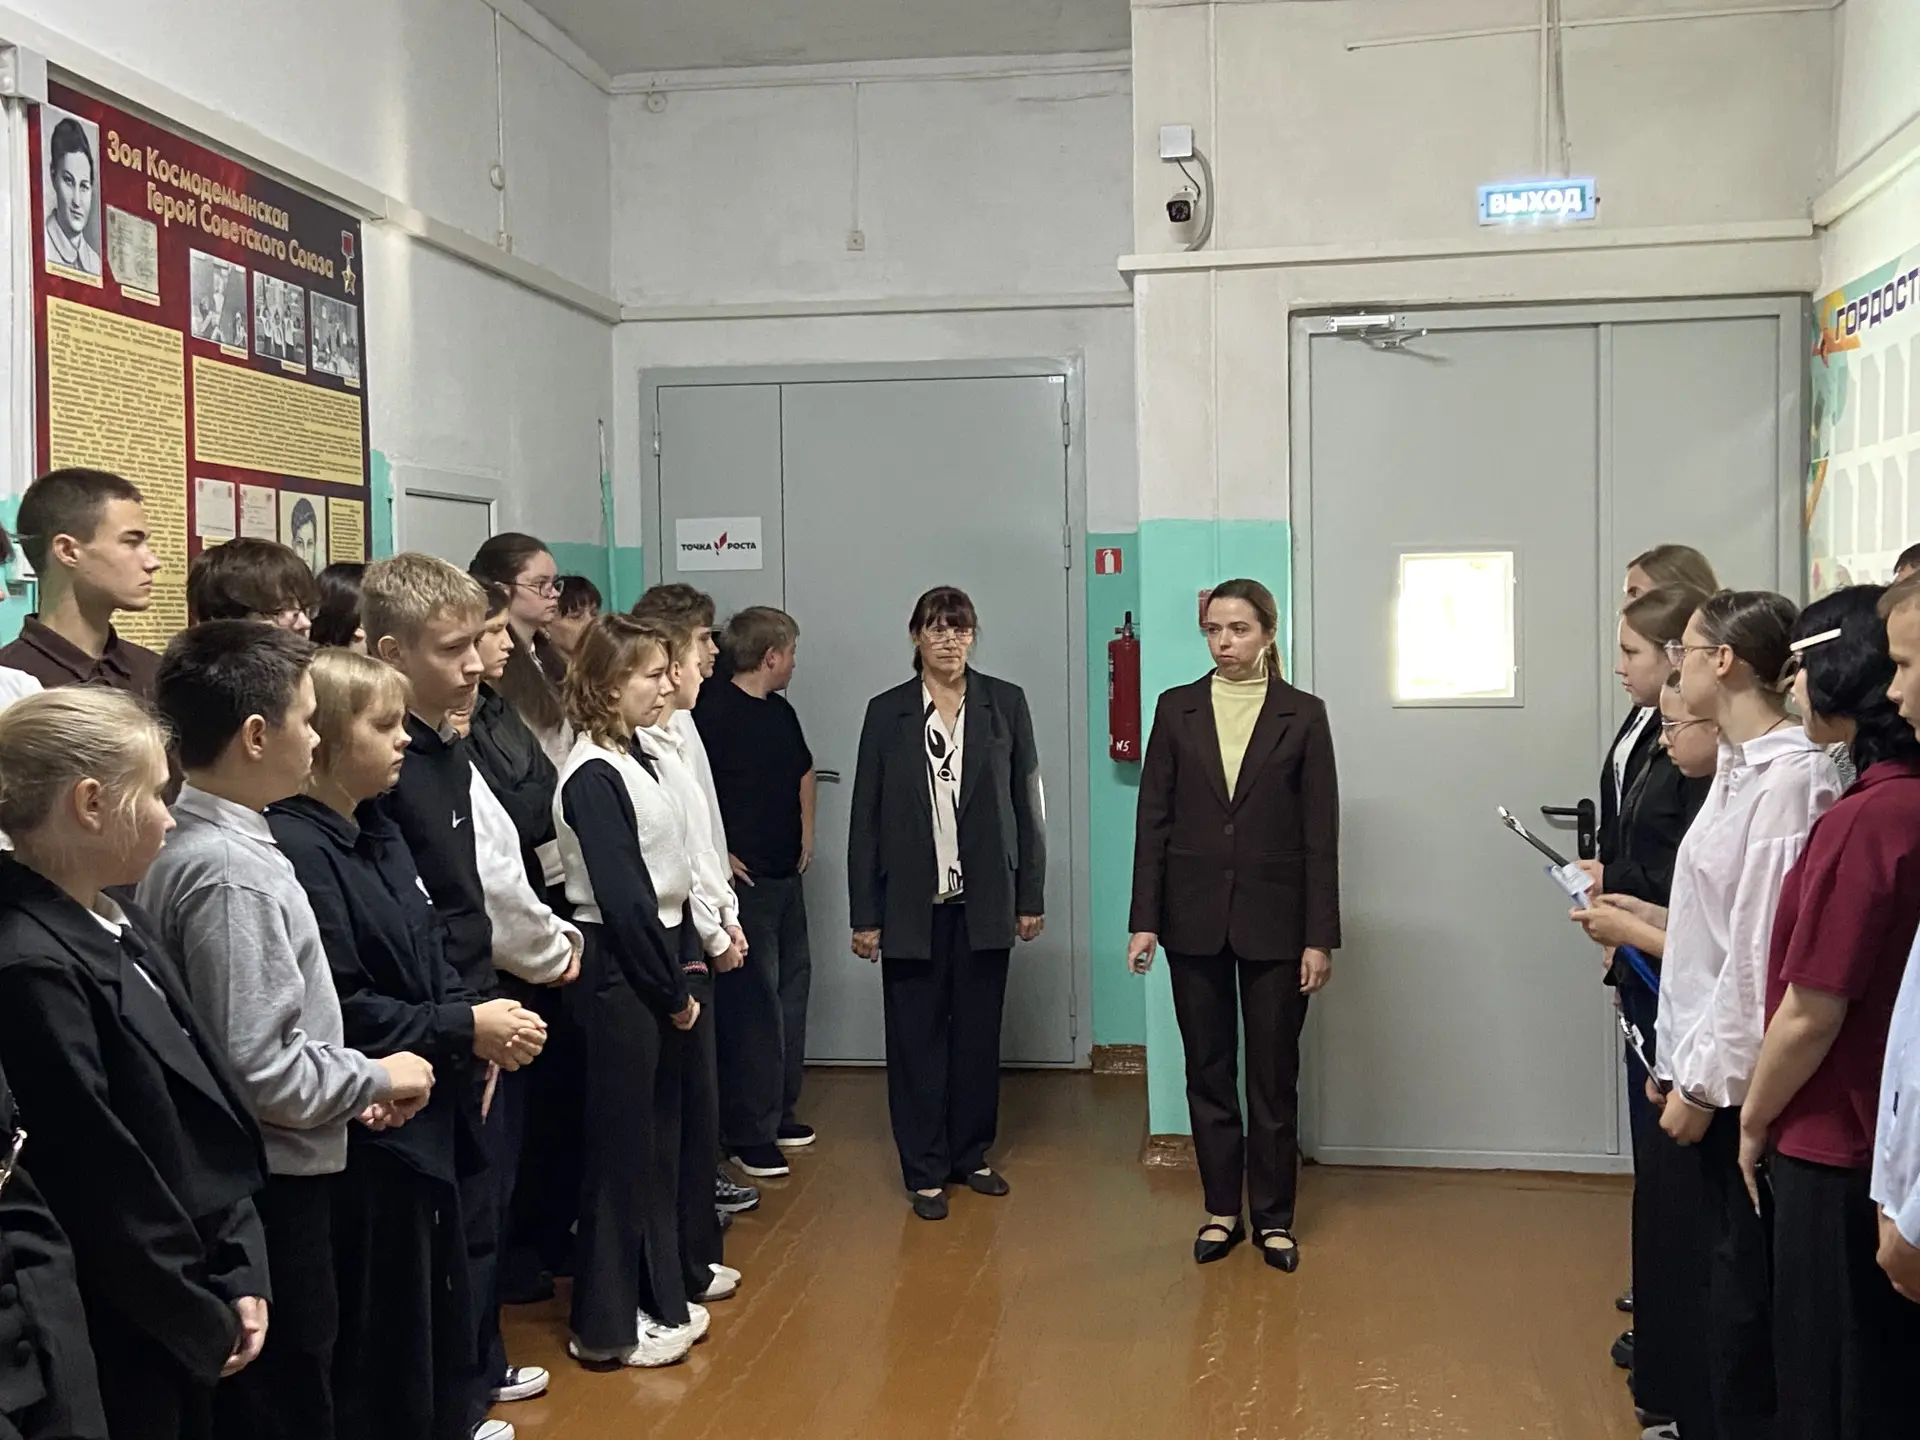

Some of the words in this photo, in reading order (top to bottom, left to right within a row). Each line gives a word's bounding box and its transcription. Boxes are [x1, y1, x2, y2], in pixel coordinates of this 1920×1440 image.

[107, 130, 142, 171] Зоя
[146, 145, 290, 232] Космодемьянская
[1489, 187, 1582, 214] ВЫХОД
[146, 181, 197, 227] Герой
[200, 202, 287, 262] Советского
[288, 239, 334, 279] Союза
[1835, 267, 1920, 341] ГОРДОСТ
[681, 543, 712, 551] ТОЧКА
[727, 542, 757, 550] РОСТА
